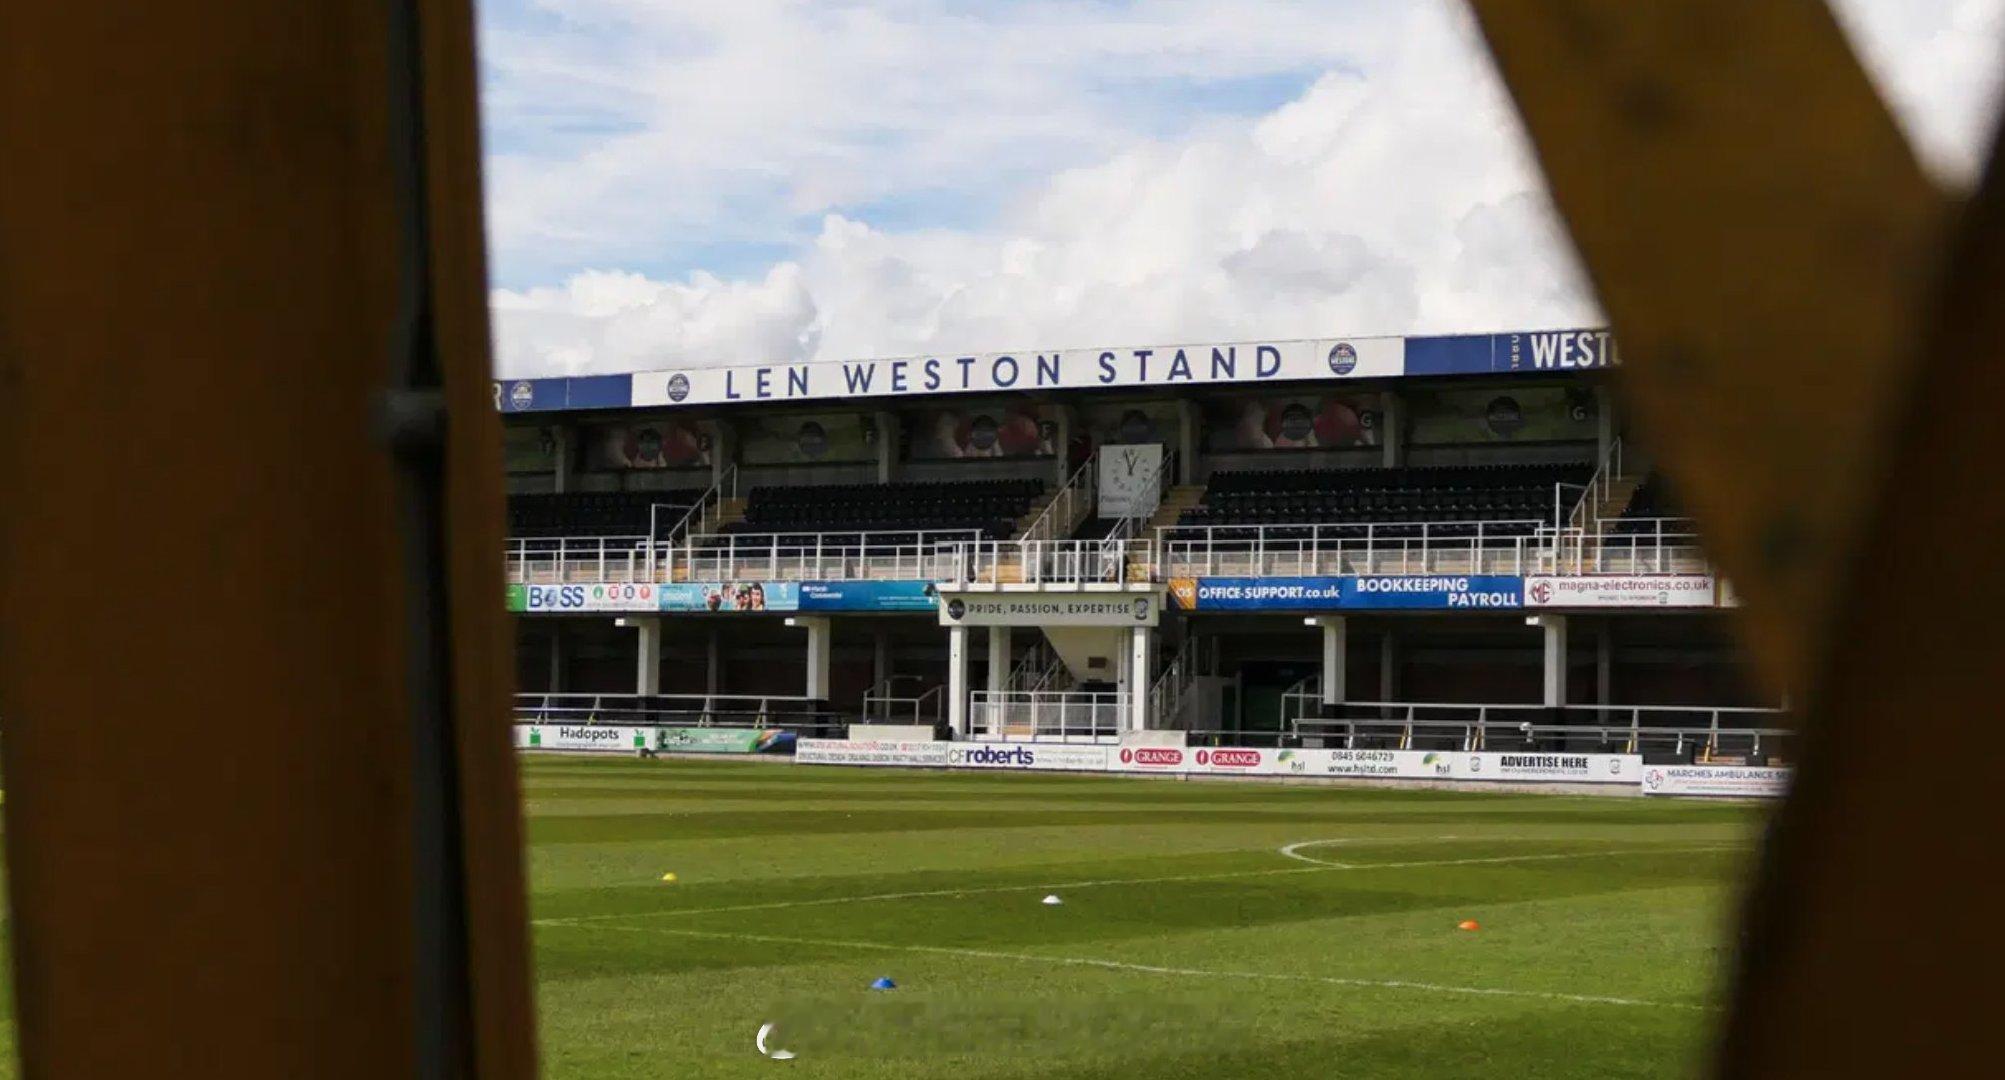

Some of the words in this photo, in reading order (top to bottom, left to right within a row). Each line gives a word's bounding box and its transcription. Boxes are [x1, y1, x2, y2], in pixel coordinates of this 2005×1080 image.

[726, 366, 808, 399] LEN
[843, 354, 1060, 395] WESTON
[1098, 346, 1281, 384] STAND
[1357, 578, 1468, 592] BOOKKEEPING
[1558, 578, 1709, 593] magna-electronics.co.uk
[1198, 585, 1340, 600] OFFICE-SUPPORT.co.uk
[1448, 592, 1518, 607] PAYROLL
[968, 604, 1007, 615] PRIDE,
[1010, 604, 1063, 615] PASSION,
[1068, 603, 1129, 614] EXPERTISE
[560, 727, 619, 742] Hadopots
[1136, 751, 1181, 763] GRANGE
[1213, 753, 1260, 765] GRANGE
[1501, 756, 1559, 768] ADVERTISE
[1562, 757, 1588, 769] HERE
[1291, 761, 1305, 772] hsl
[1435, 764, 1450, 774] hsl
[1667, 769, 1712, 779] MARCHES
[1714, 770, 1774, 780] AMBULANCE
